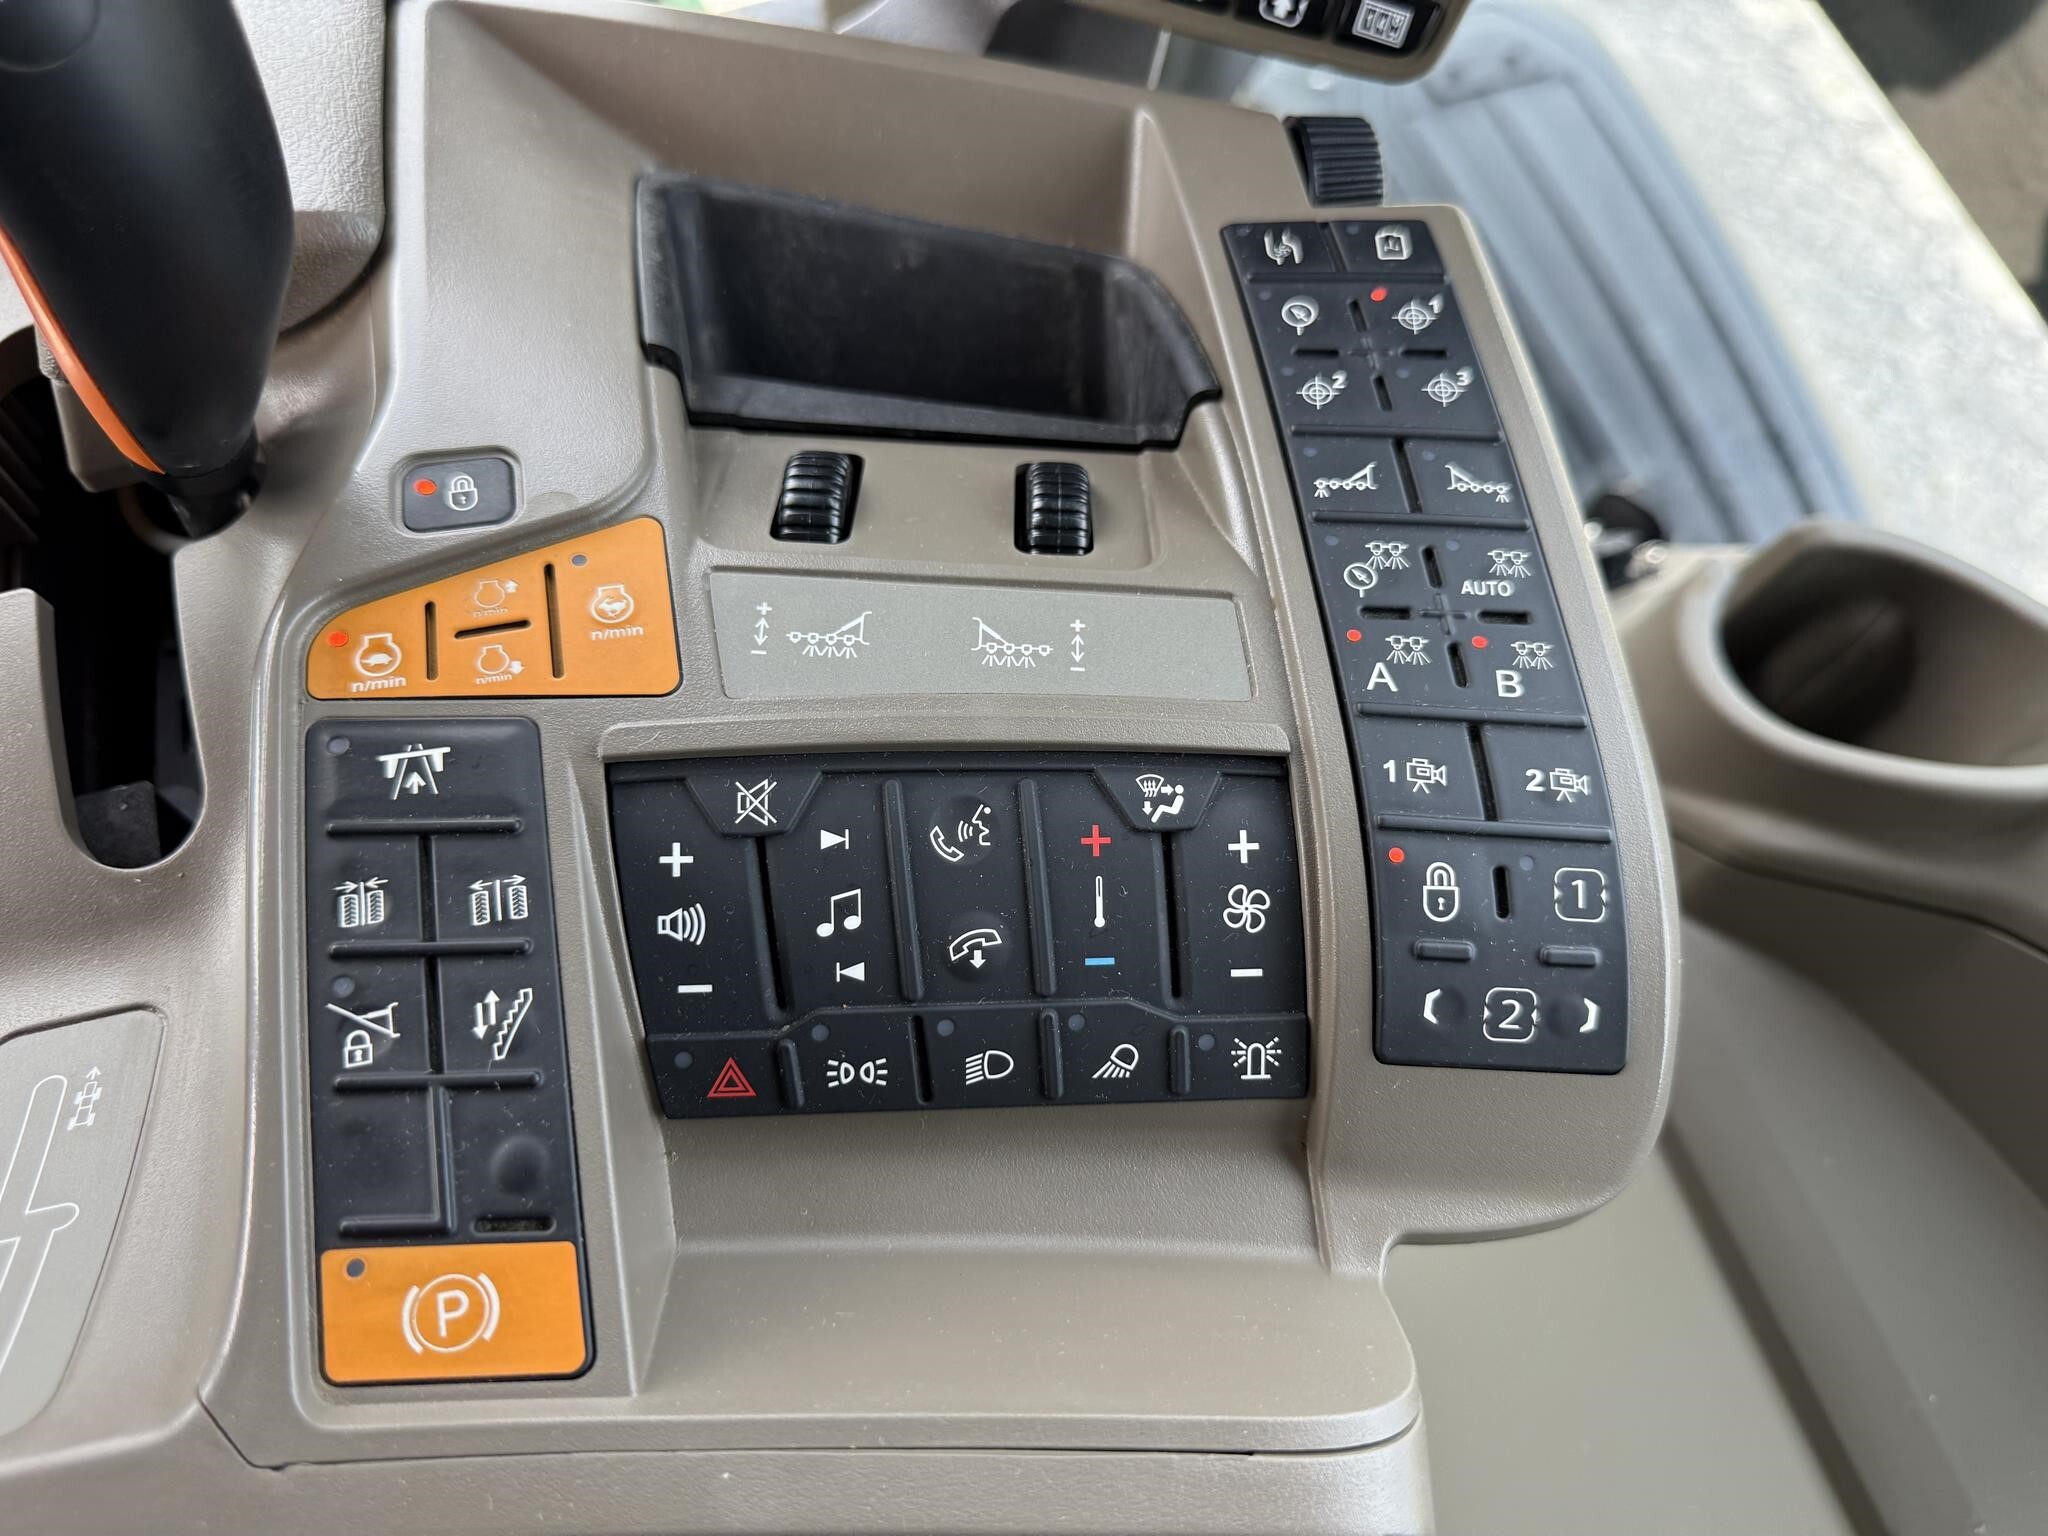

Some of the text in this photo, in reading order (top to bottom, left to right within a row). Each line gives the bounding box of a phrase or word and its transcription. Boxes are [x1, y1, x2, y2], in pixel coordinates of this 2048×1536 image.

[1331, 370, 1348, 389] 2
[1455, 366, 1474, 386] 3
[1460, 579, 1515, 598] AUTO
[590, 624, 644, 641] n/min
[351, 674, 407, 693] n/min
[1366, 662, 1399, 692] A
[1495, 669, 1525, 698] B
[1383, 759, 1397, 783] 1
[1525, 768, 1547, 791] 2
[1570, 879, 1588, 909] 1
[1497, 999, 1522, 1030] 2
[436, 1288, 470, 1338] P
